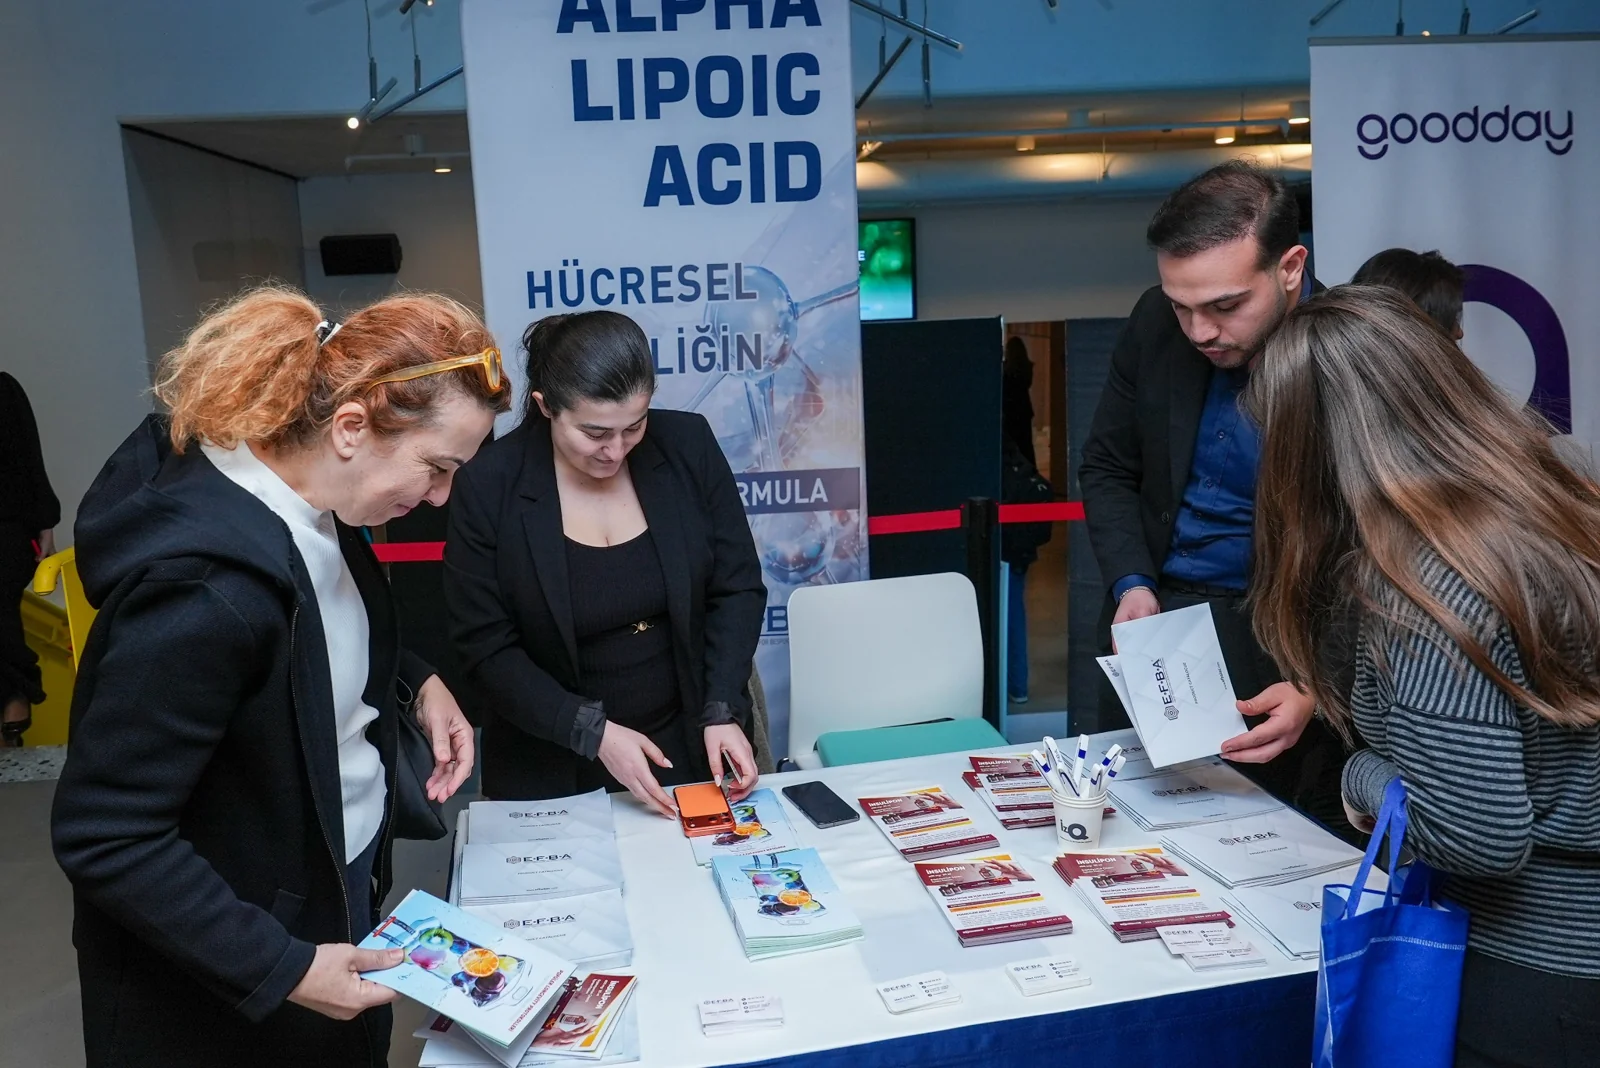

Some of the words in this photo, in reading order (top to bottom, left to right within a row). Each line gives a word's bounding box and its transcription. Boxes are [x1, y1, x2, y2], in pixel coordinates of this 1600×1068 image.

[570, 52, 821, 122] LIPOIC
[1356, 104, 1575, 161] goodday
[643, 140, 822, 208] ACID
[526, 258, 758, 309] HÜCRESEL
